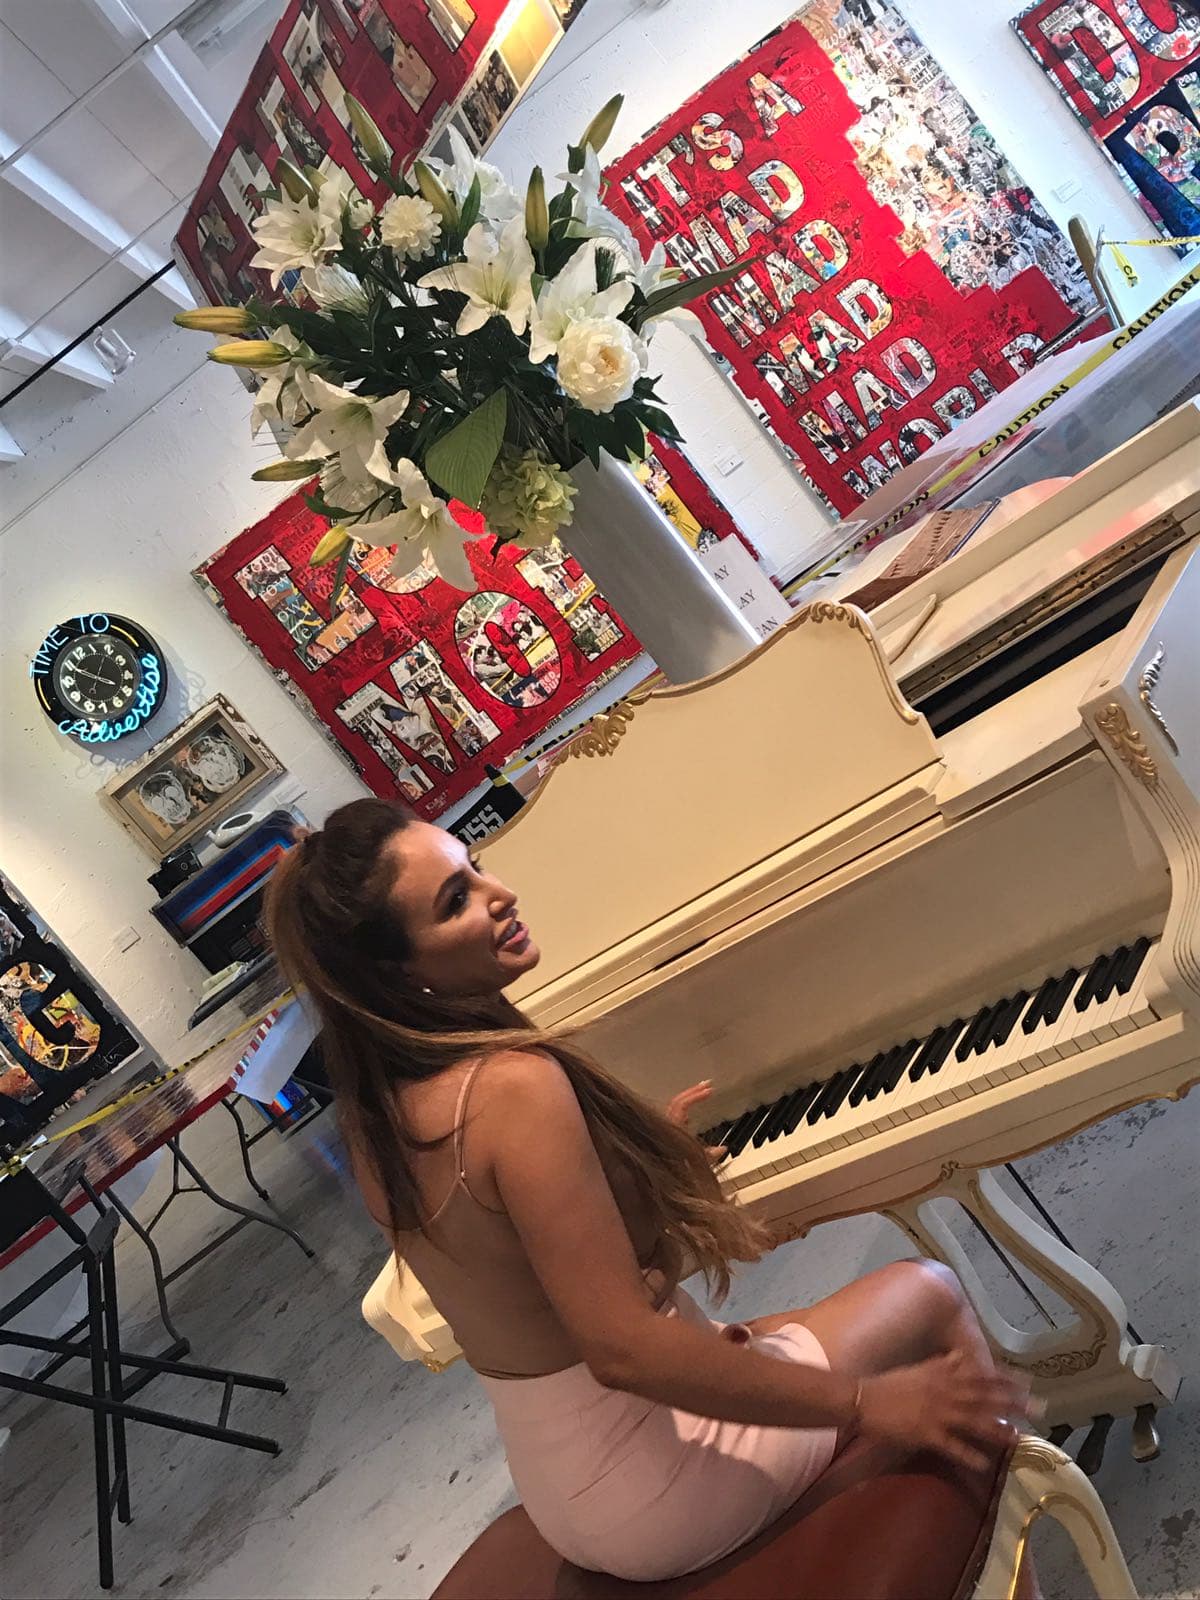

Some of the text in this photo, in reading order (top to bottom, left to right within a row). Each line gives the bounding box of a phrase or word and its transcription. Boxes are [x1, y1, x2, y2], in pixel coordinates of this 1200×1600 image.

[619, 71, 806, 232] IT'S A
[664, 159, 806, 281] MAD
[708, 219, 851, 349] MAD
[1112, 273, 1200, 351] CAUTION
[753, 278, 893, 408] MAD
[797, 336, 938, 465] MAD
[978, 383, 1069, 458] CAUTION
[29, 612, 110, 679] TIME TO
[88, 643, 97, 654] 1
[104, 644, 115, 656] 2
[72, 646, 86, 661] 12
[115, 655, 127, 667] 3
[60, 675, 75, 689] 10
[122, 670, 134, 680] 4
[70, 690, 81, 703] 9
[122, 685, 133, 698] 5
[83, 700, 96, 713] 8
[98, 702, 108, 714] 7
[112, 697, 124, 708] 6
